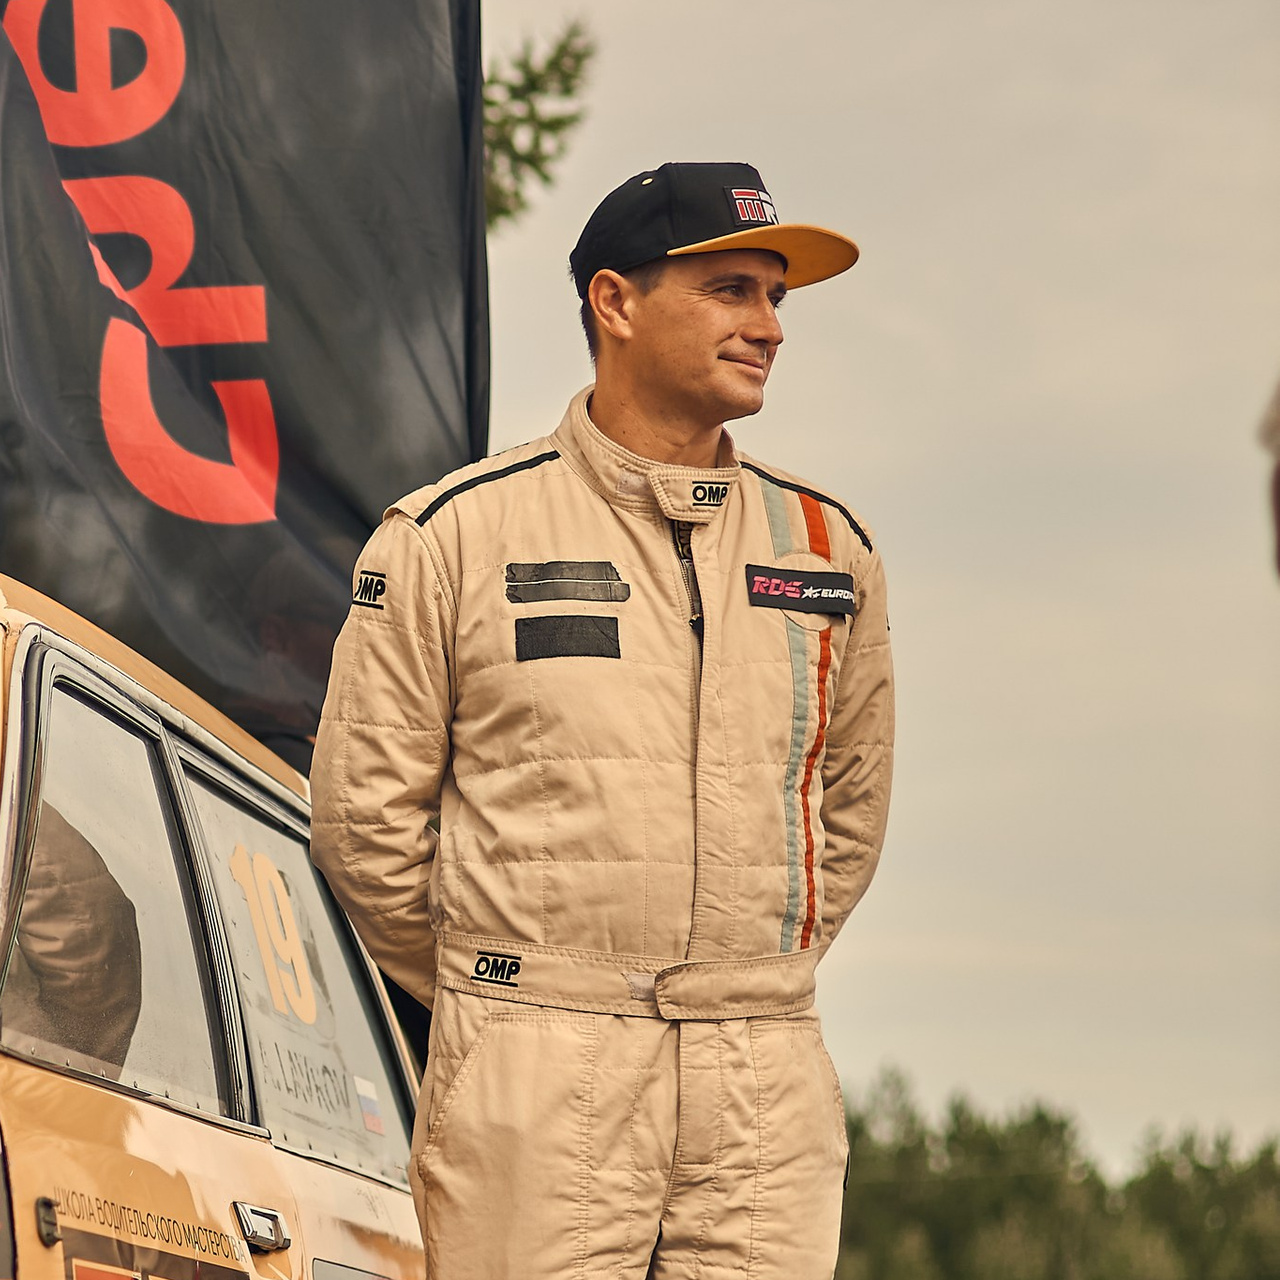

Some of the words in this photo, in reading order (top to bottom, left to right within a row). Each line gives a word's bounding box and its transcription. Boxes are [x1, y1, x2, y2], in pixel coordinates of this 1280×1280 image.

[692, 485, 728, 503] OMP
[752, 575, 804, 599] RDS
[229, 843, 317, 1025] 19
[474, 956, 521, 981] OMP
[54, 1186, 96, 1223] ШКОЛА
[95, 1197, 183, 1247] ВОДИТЕЛЬСКОГО
[181, 1222, 248, 1264] МАСТЕРСТВА
